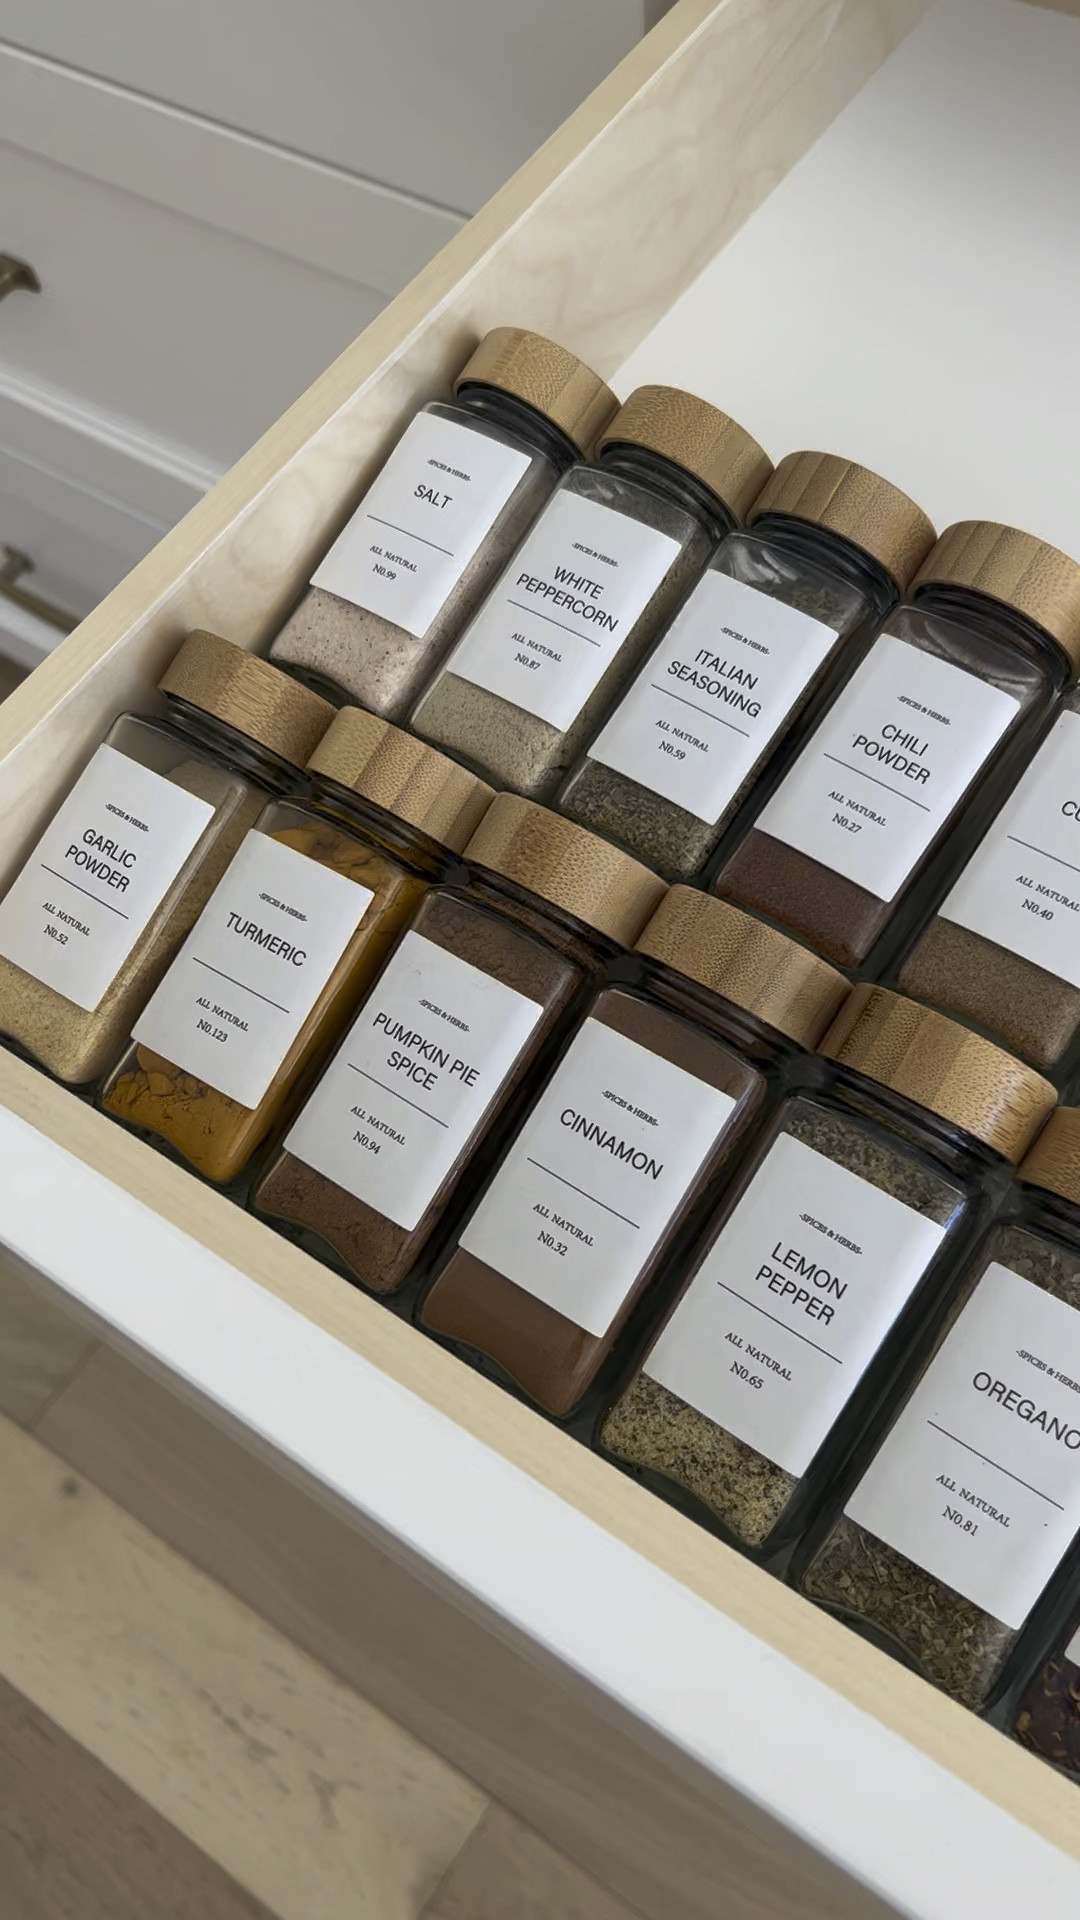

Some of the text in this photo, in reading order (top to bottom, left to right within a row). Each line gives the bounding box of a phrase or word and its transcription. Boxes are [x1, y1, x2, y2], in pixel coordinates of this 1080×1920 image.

[414, 485, 453, 509] SALT
[369, 545, 417, 572] ALL NATURAL
[516, 574, 619, 632] PEPPERCORN
[554, 566, 604, 600] WHITE
[512, 633, 562, 662] ALL NATURAL
[667, 661, 761, 718] SEASONING
[694, 649, 759, 690] ITALIAN
[655, 720, 709, 752] ALL NATURAL
[881, 724, 929, 756] CHILI
[852, 736, 931, 784] POWDER
[828, 791, 886, 826] ALL NATURAL
[65, 845, 130, 893] POWDER
[82, 829, 137, 868] GARLIC
[1016, 875, 1033, 889] ALL
[42, 902, 90, 936] ALL NATURAL
[226, 912, 306, 966] TURMERIC
[196, 997, 249, 1032] ALL NATURAL
[372, 1012, 480, 1087] PUMPKIN PIE
[386, 1051, 438, 1091] SPICE
[350, 1106, 406, 1145] ALL NATURAL
[560, 1109, 664, 1180] CINNAMON
[533, 1203, 594, 1247] ALL NATURAL
[771, 1242, 848, 1300] LEMON
[755, 1265, 835, 1326] PEPPER
[724, 1332, 792, 1381] ALL NATURAL
[972, 1372, 1080, 1450] OREGANO
[936, 1474, 1011, 1527] ALL NATURAL
